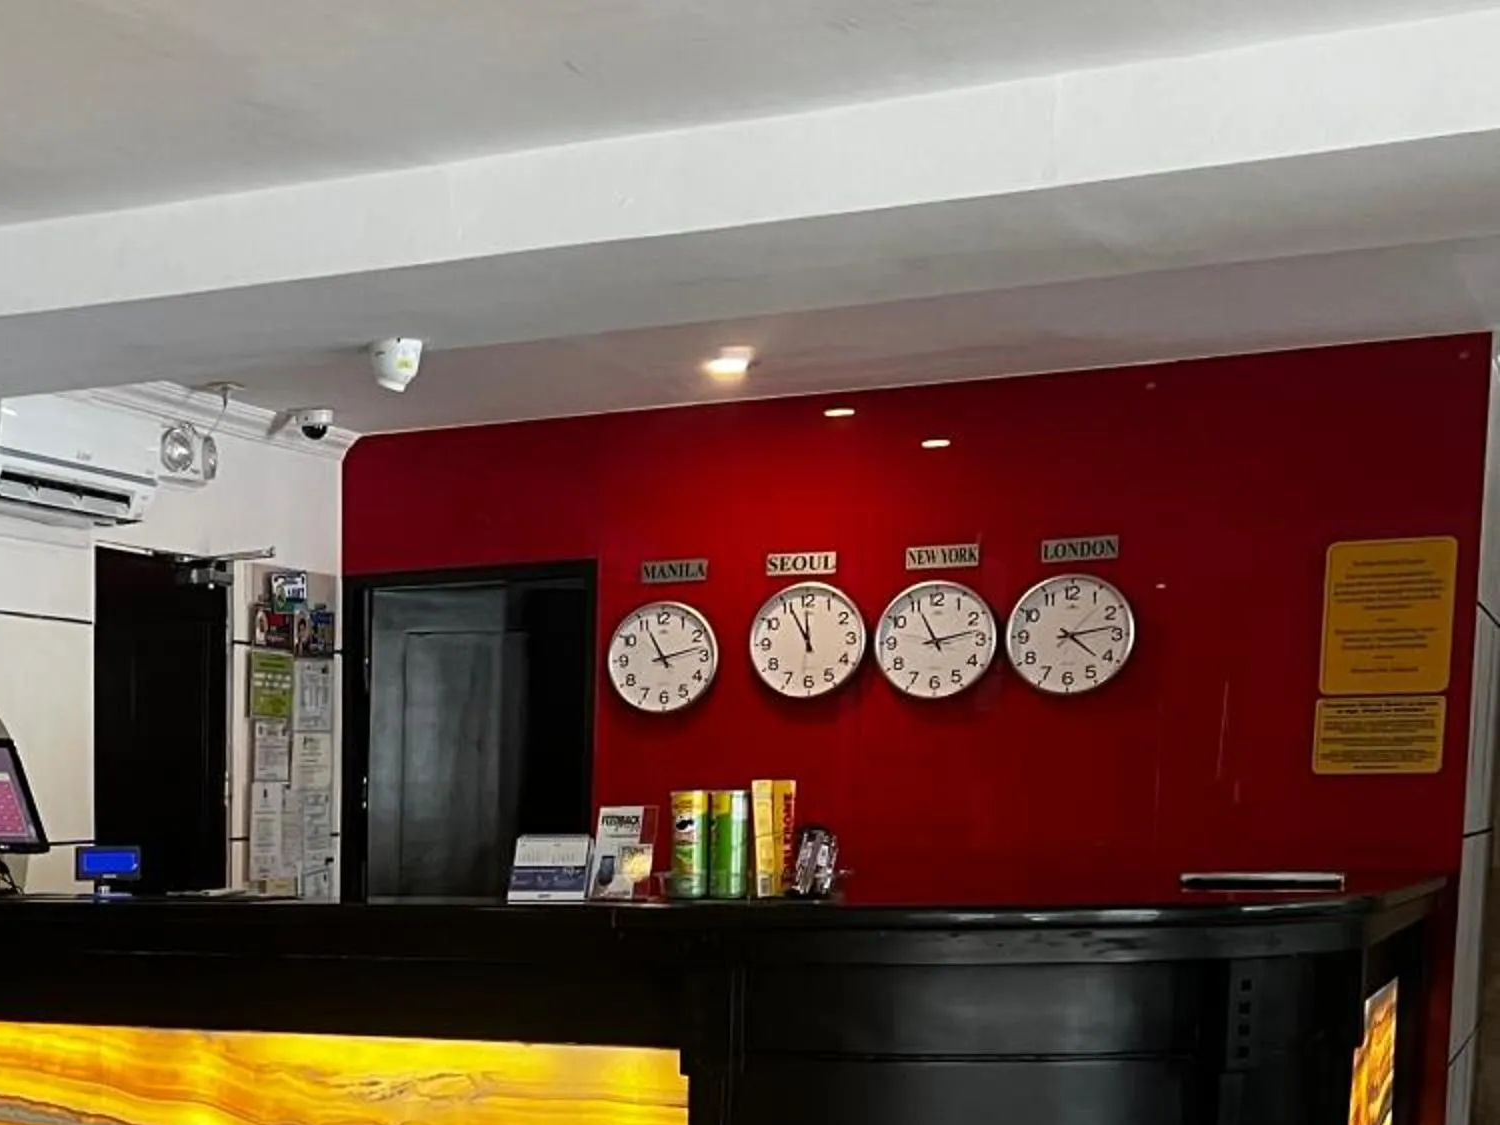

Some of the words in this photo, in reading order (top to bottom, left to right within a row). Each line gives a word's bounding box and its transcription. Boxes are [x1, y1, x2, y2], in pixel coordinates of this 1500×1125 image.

[908, 549, 937, 565] NEW
[941, 547, 977, 564] YORK
[1043, 539, 1117, 560] LONDON
[768, 555, 834, 572] SEOUL
[643, 562, 705, 580] MANILA
[930, 592, 945, 607] 12
[1044, 592, 1055, 607] 11
[1065, 585, 1080, 601] 12
[801, 594, 816, 608] 12
[911, 600, 920, 613] 11
[783, 602, 793, 615] 11
[1025, 608, 1040, 623] 10
[1104, 605, 1117, 621] 2
[657, 611, 670, 625] 12
[767, 617, 780, 631] 10
[838, 611, 849, 625] 2
[893, 615, 907, 629] 10
[968, 611, 979, 626] 2
[639, 619, 649, 632] 11
[692, 629, 703, 643] 2
[845, 631, 857, 645] 3
[975, 631, 986, 646] 3
[1017, 630, 1029, 644] 9
[1111, 627, 1123, 642] 3
[761, 638, 772, 651] 9
[886, 636, 897, 651] 9
[619, 654, 629, 668] 9
[699, 649, 709, 662] 3
[839, 653, 849, 665] 4
[966, 654, 978, 666] 4
[1025, 651, 1036, 665] 8
[1102, 649, 1113, 662] 4
[768, 657, 779, 671] 8
[893, 657, 904, 671] 8
[692, 670, 702, 682] 4
[784, 671, 793, 685] 7
[823, 668, 835, 682] 5
[909, 671, 919, 685] 7
[951, 669, 963, 683] 5
[1041, 665, 1053, 680] 7
[1061, 671, 1074, 685] 6
[1085, 665, 1097, 679] 5
[626, 673, 636, 687] 8
[803, 675, 815, 689] 6
[929, 675, 941, 690] 6
[640, 687, 650, 700] 7
[659, 691, 669, 704] 6
[678, 683, 688, 698] 5
